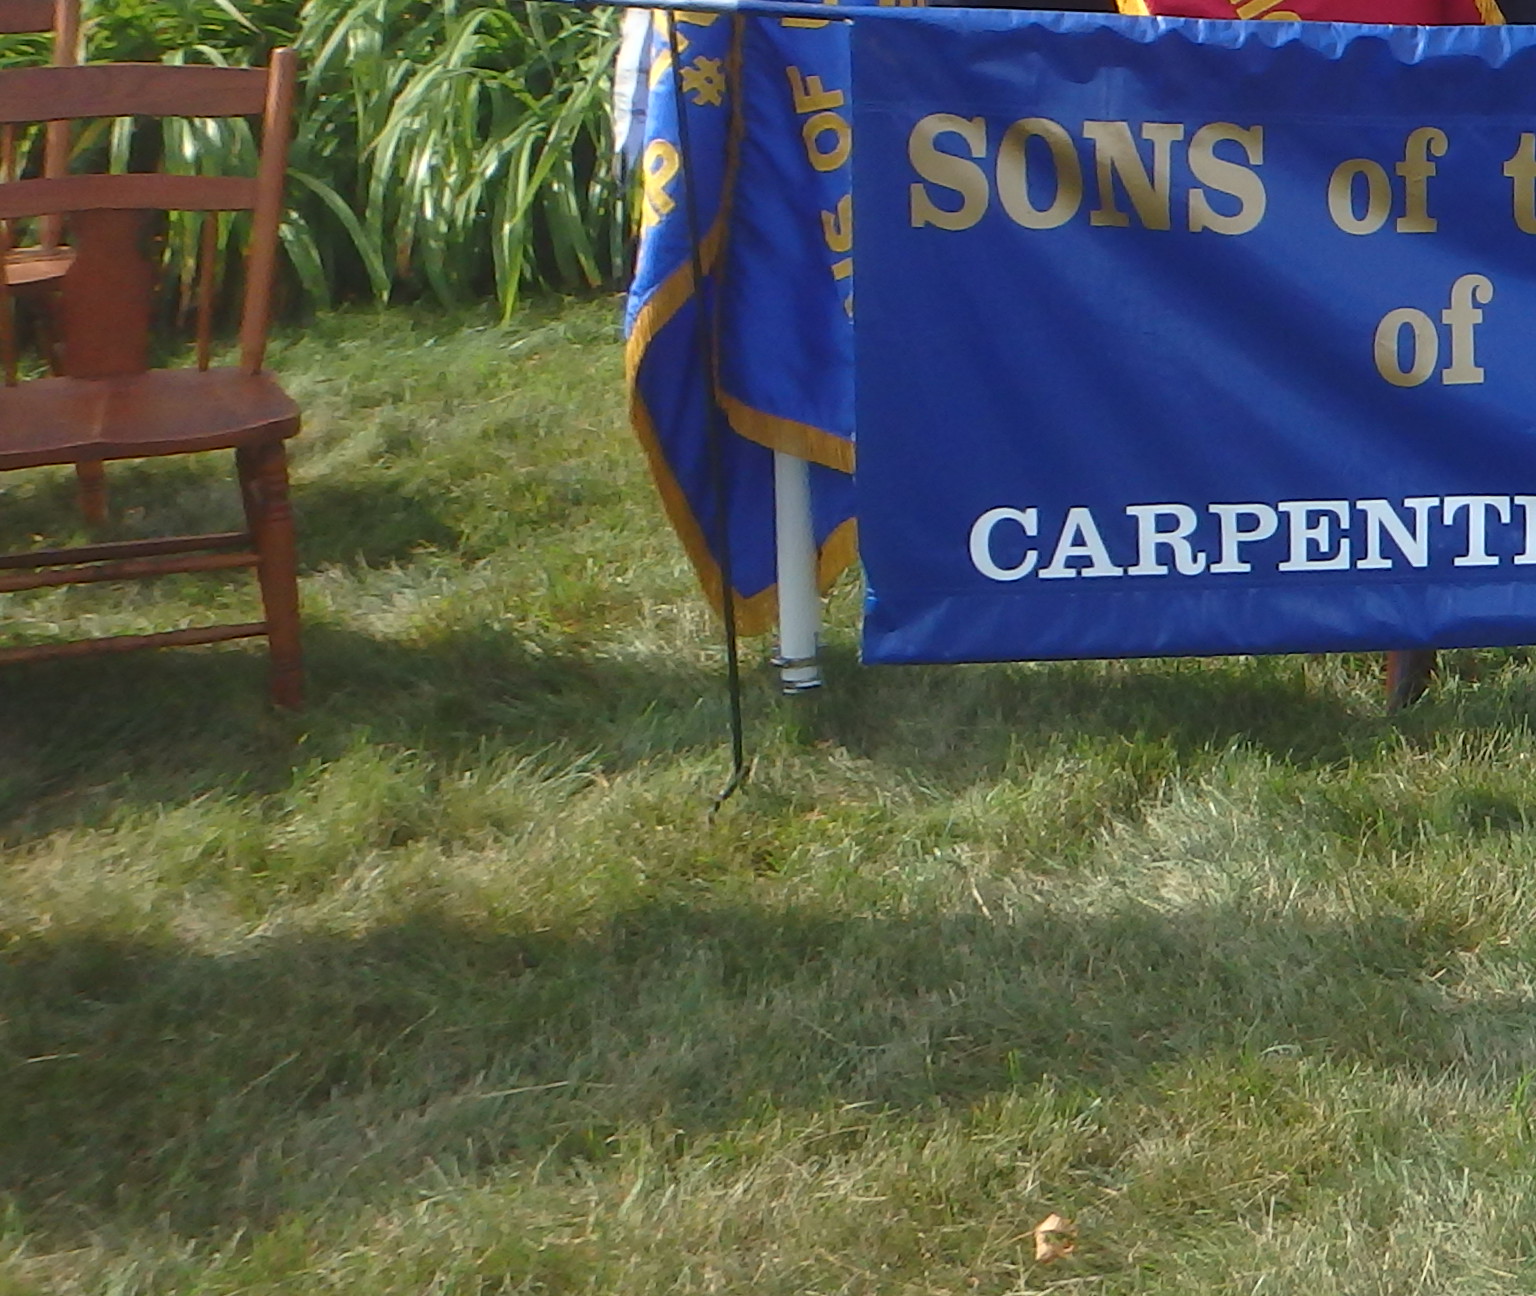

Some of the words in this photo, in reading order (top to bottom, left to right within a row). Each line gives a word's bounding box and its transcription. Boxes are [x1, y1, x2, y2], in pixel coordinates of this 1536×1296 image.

[786, 65, 852, 172] OF
[908, 113, 1266, 235] SONS
[1327, 126, 1448, 235] of
[1373, 273, 1494, 387] of
